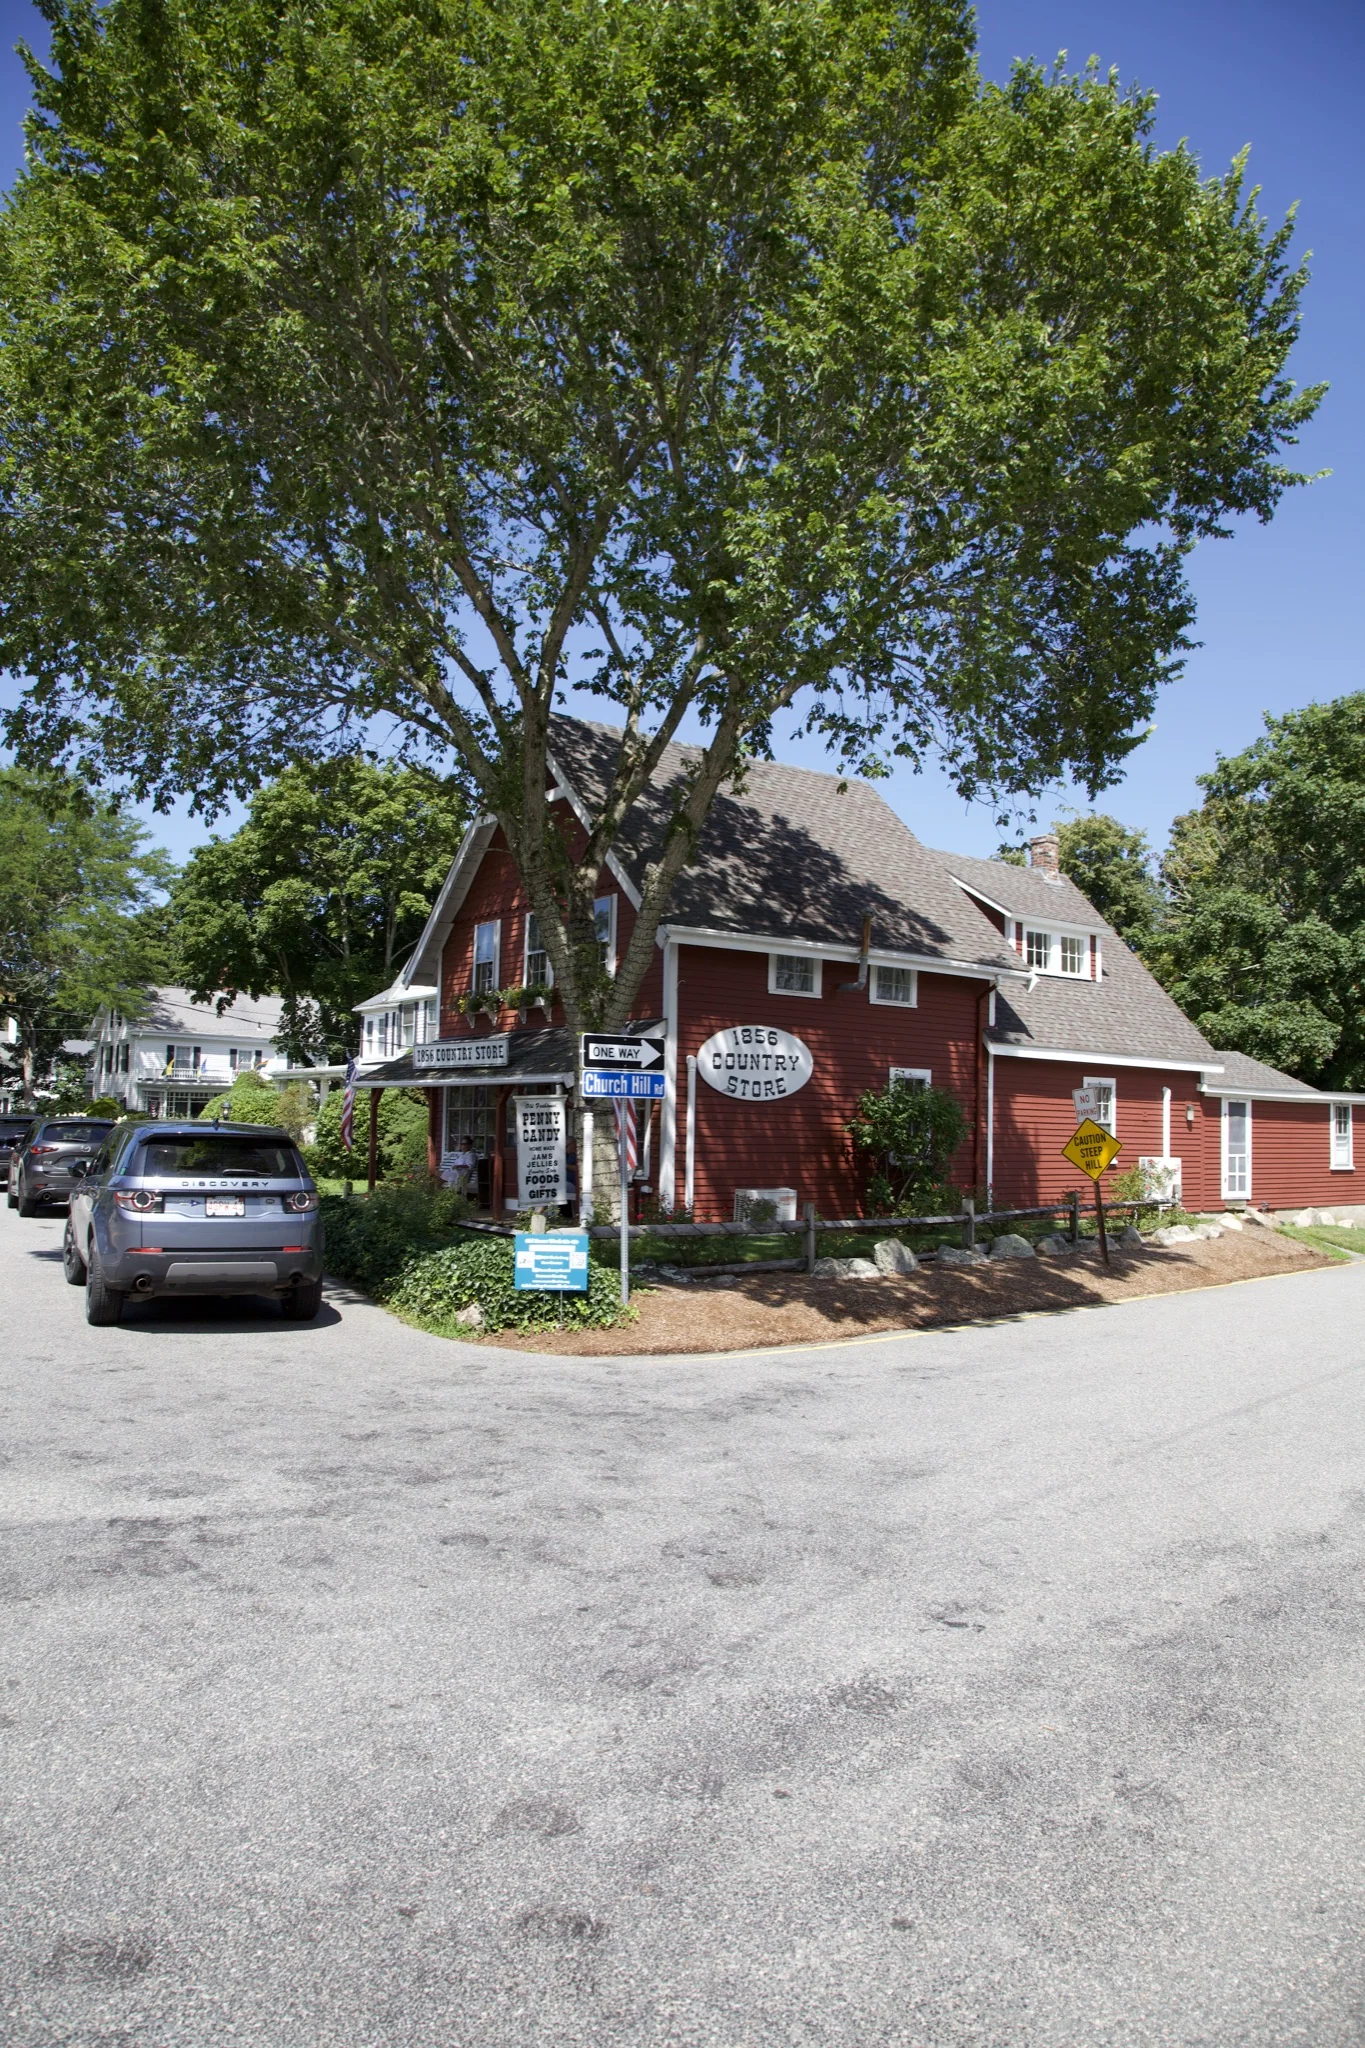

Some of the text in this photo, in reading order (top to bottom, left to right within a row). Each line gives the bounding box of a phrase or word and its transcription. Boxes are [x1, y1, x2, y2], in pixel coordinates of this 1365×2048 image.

[733, 1028, 778, 1046] 1856
[417, 1045, 503, 1062] 1856 COUNTRY STORE
[593, 1046, 640, 1059] ONE WAY
[712, 1052, 800, 1071] COUNTRY
[585, 1073, 628, 1094] Church
[632, 1075, 651, 1094] Hill
[728, 1075, 787, 1097] STORE
[1079, 1094, 1090, 1104] NO
[1077, 1107, 1097, 1117] PARKING
[522, 1112, 560, 1126] PENNY
[523, 1128, 560, 1142] CANDY
[1074, 1133, 1107, 1147] CAUTION
[1080, 1146, 1103, 1158] STEEP
[526, 1160, 558, 1168] JELLIES
[1085, 1159, 1102, 1170] HILL
[525, 1174, 560, 1185] FOODS
[528, 1188, 557, 1199] GIFTS
